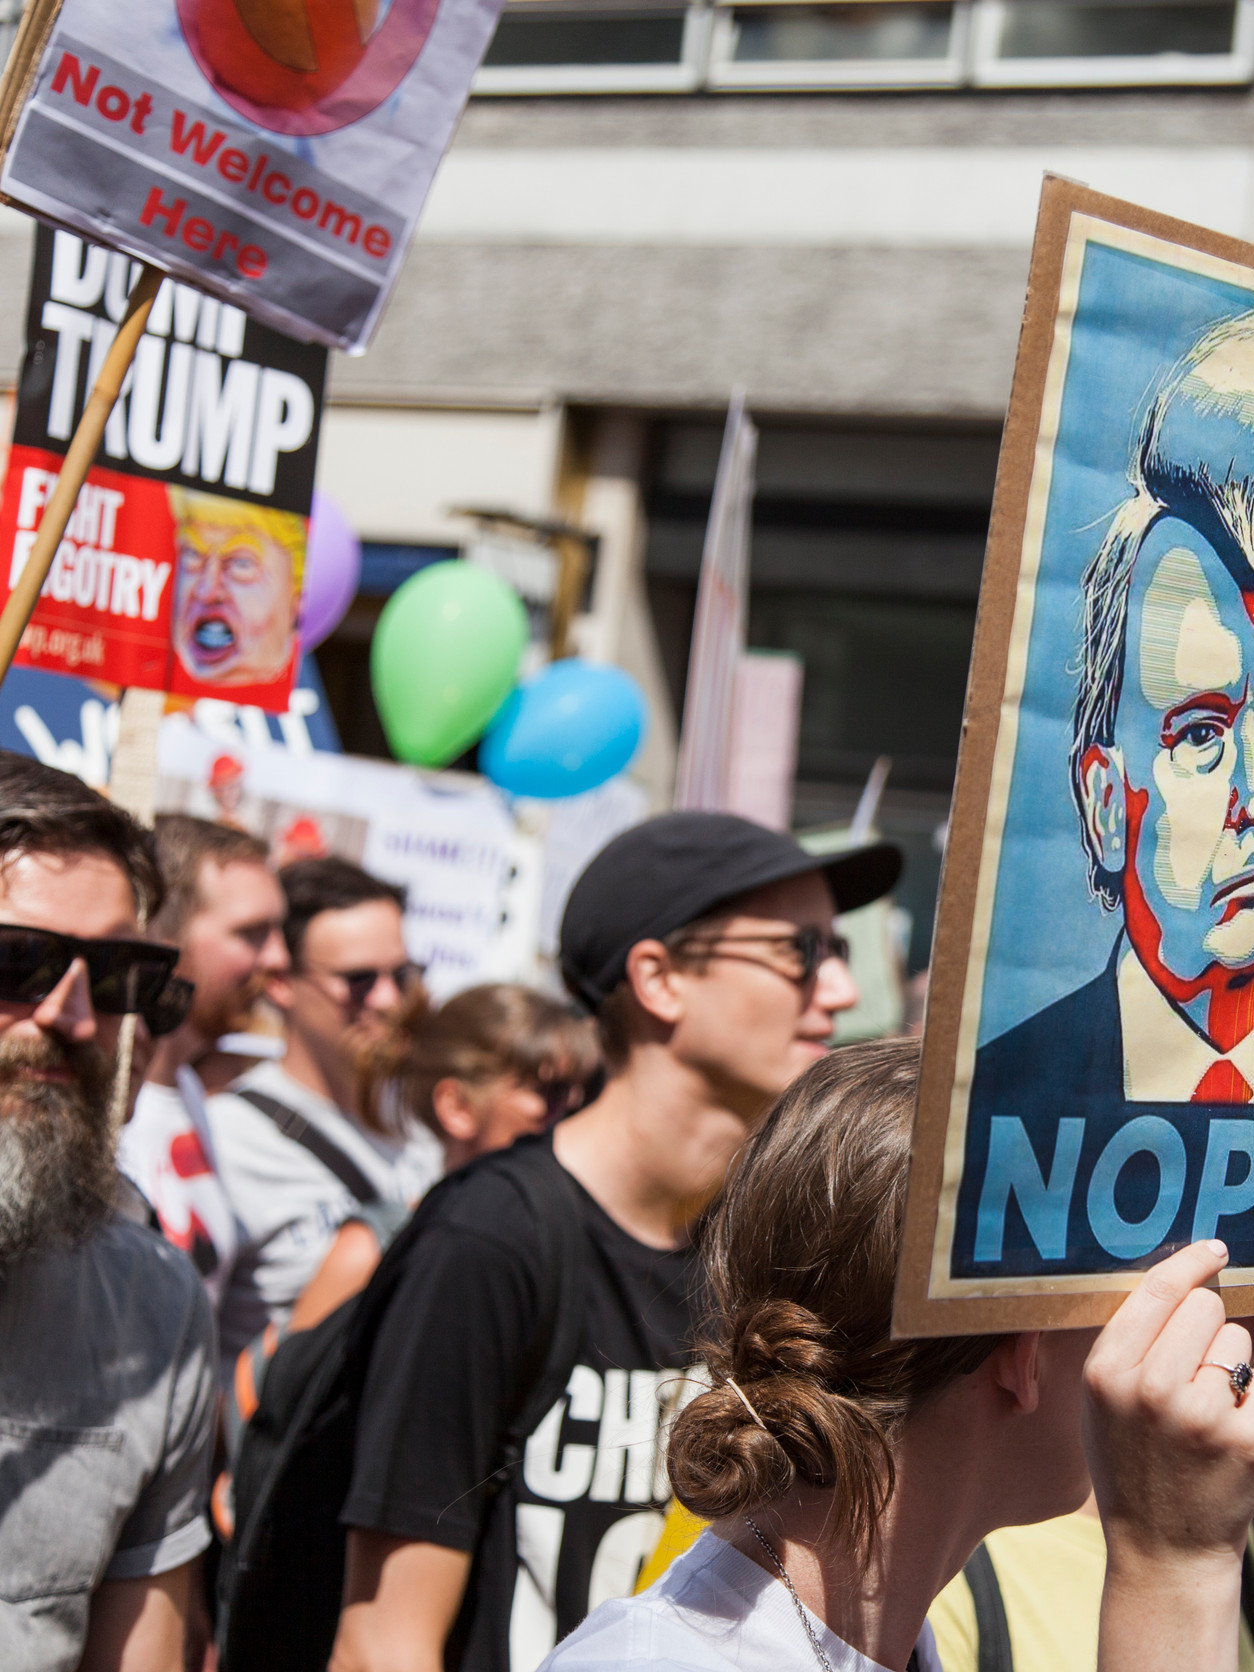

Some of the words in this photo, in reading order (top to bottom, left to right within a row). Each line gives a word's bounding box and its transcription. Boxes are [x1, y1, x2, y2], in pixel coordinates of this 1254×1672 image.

[50, 50, 154, 136] Not
[168, 109, 393, 260] Welcome
[138, 186, 269, 281] Here
[16, 466, 125, 550] FHT
[8, 529, 171, 622] GOTRY
